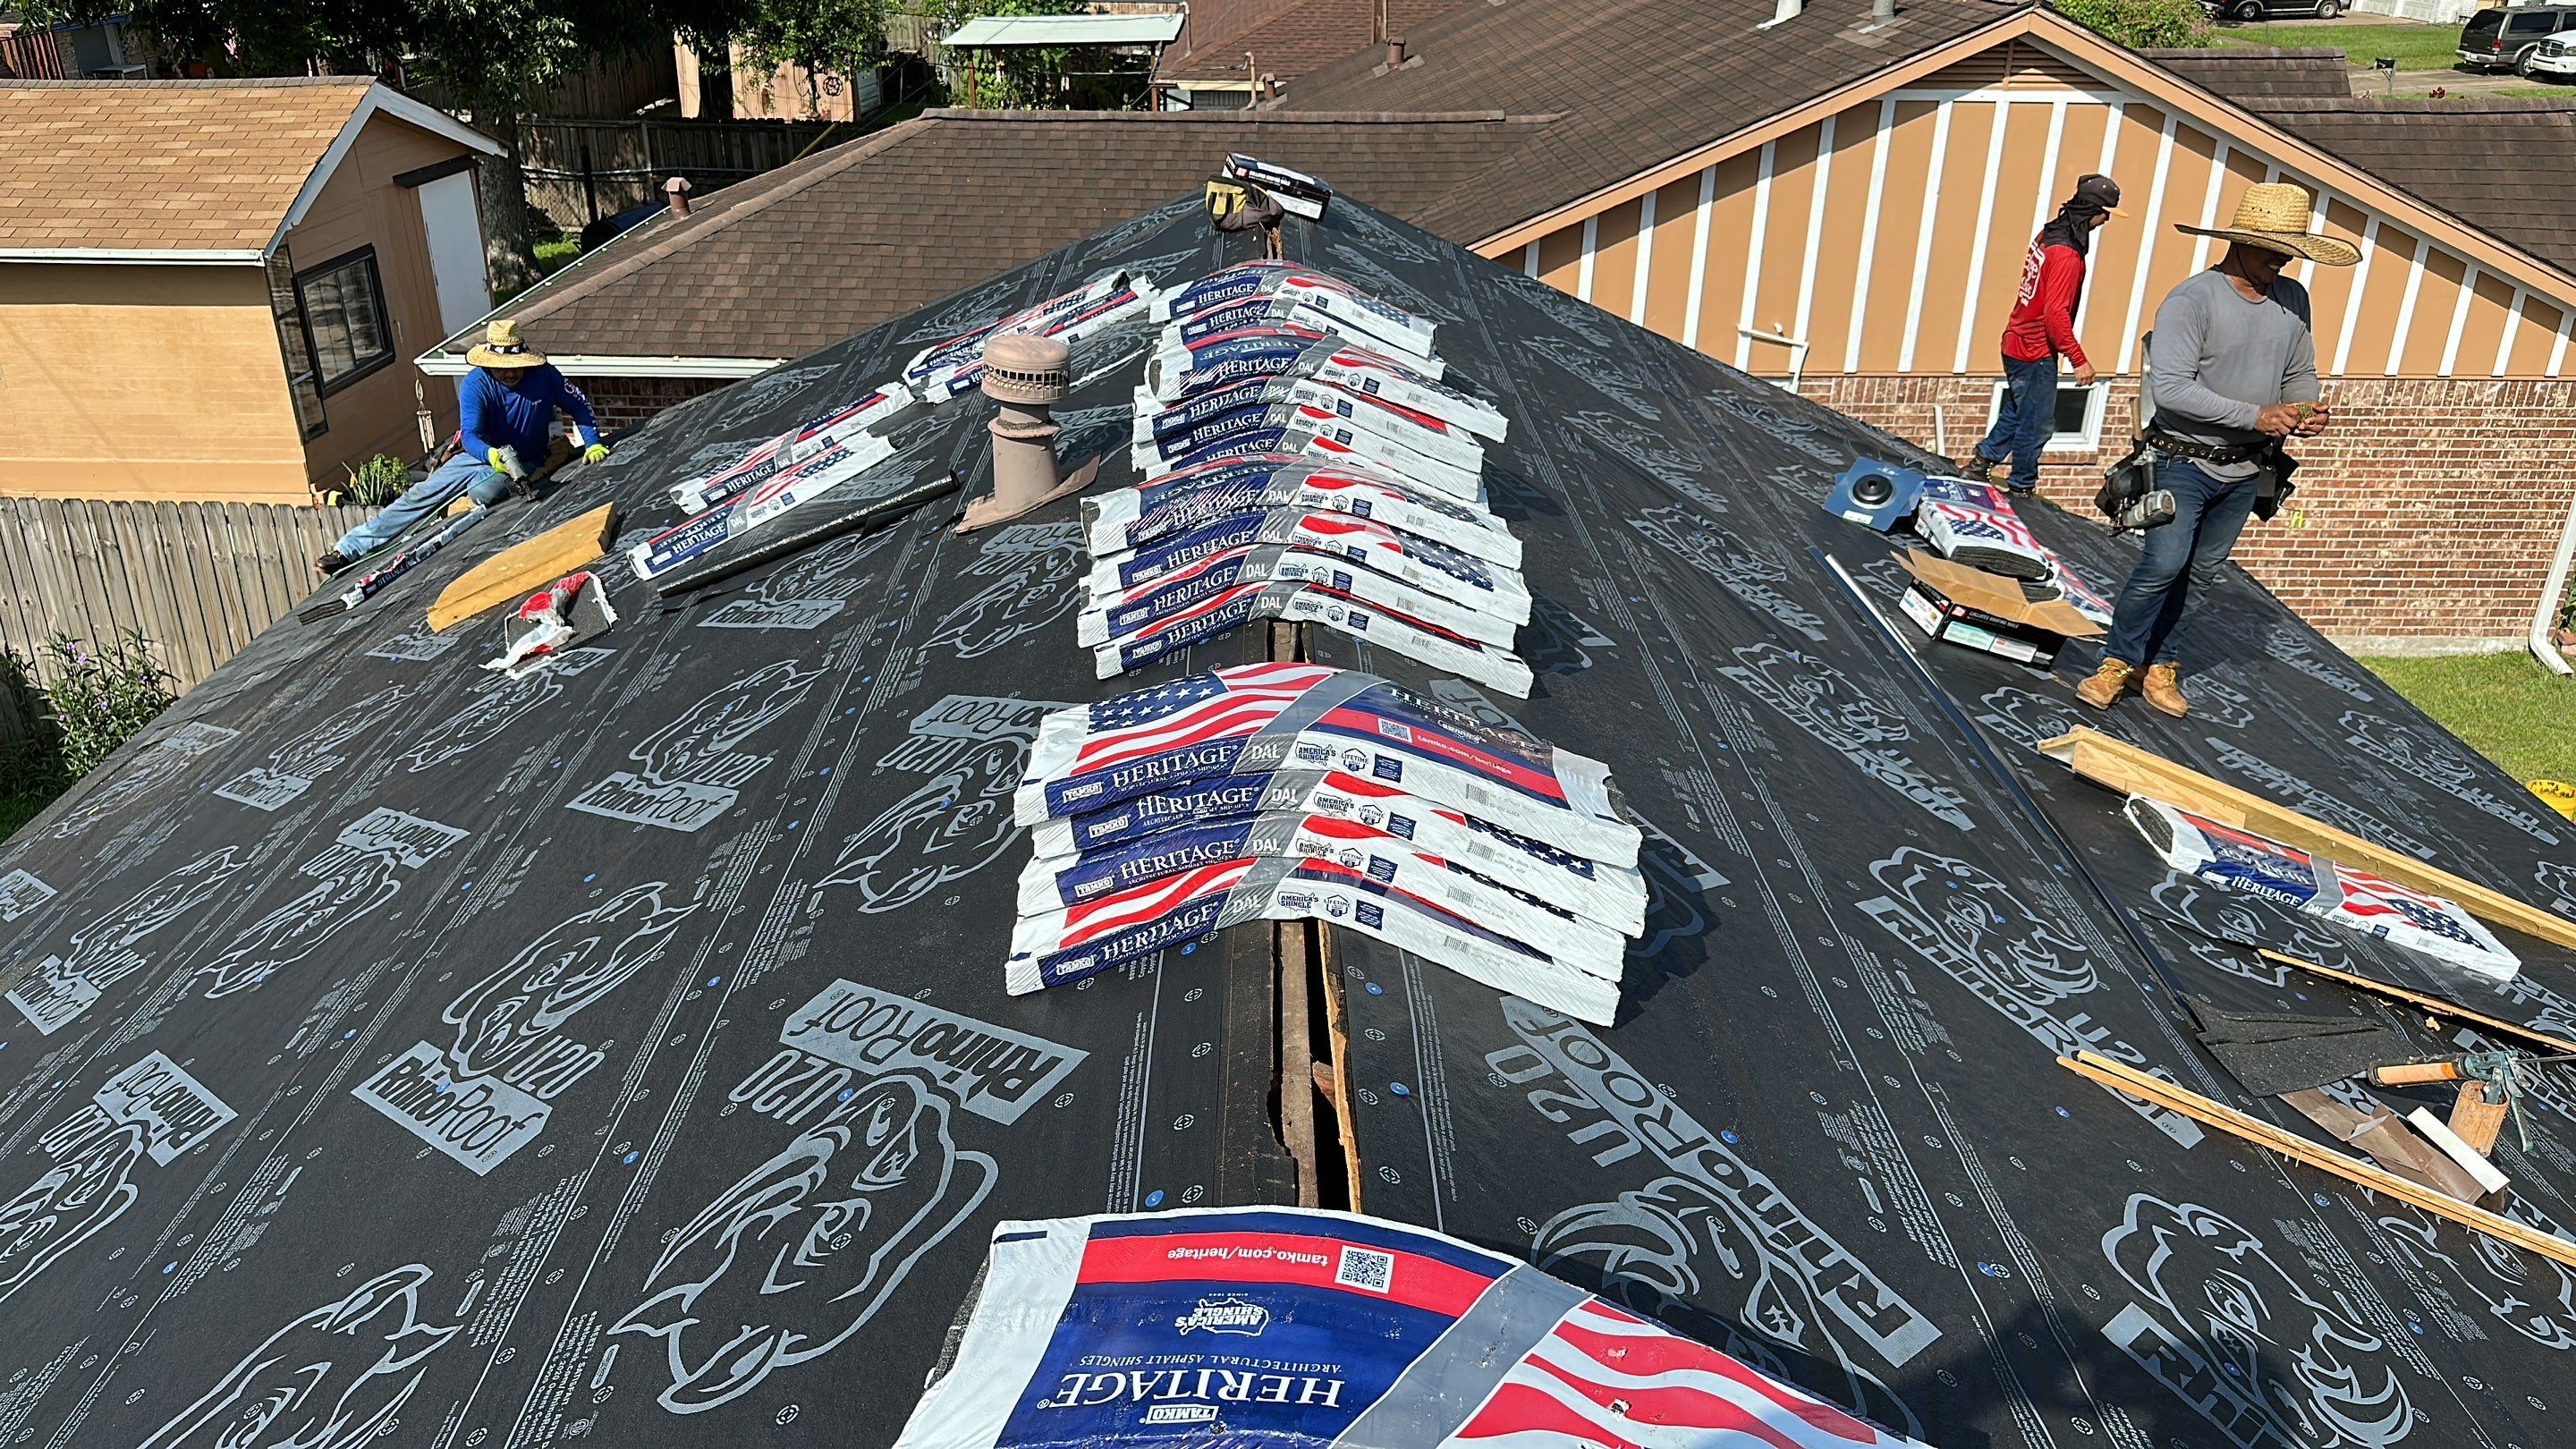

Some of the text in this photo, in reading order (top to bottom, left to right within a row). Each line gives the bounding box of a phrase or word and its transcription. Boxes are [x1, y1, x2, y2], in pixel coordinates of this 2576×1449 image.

[1260, 284, 1275, 292] DAL
[1271, 309, 1284, 318] DAL
[1298, 361, 1315, 373] DAL
[1270, 413, 1286, 423] DAL
[1282, 442, 1299, 452] DAL
[1267, 491, 1289, 503] DAL
[730, 516, 746, 527] DAL
[1262, 530, 1281, 542] DAL
[1246, 564, 1267, 577] DAL
[1260, 596, 1283, 609] DAL
[1252, 744, 1281, 760] DAL
[1298, 746, 1336, 757] AMERICA'S
[1298, 753, 1329, 761] SHINGLE
[1342, 751, 1369, 765] LIFETIME
[1271, 787, 1299, 803] DAL
[1252, 837, 1281, 852] DAL
[1233, 895, 1262, 914] DAL
[1280, 894, 1318, 903] AMERICA'S
[1280, 901, 1312, 909] SHINGLE
[1324, 898, 1352, 908] LIFETIME
[2306, 903, 2324, 916] DAL
[504, 1035, 606, 1100] U20
[1485, 1045, 1643, 1167] U20
[1167, 1246, 1328, 1267] tamko.com/heritage
[1194, 1305, 1263, 1317] SHINGLE
[1175, 1314, 1261, 1327] AMERICA'S
[565, 1311, 588, 1352] Copyright
[583, 1322, 602, 1355] MEETS
[552, 1359, 566, 1380] 2020
[1079, 1354, 1342, 1373] ARCHITECTURAL ASPHALT SHINGLES
[538, 1380, 556, 1411] Owens
